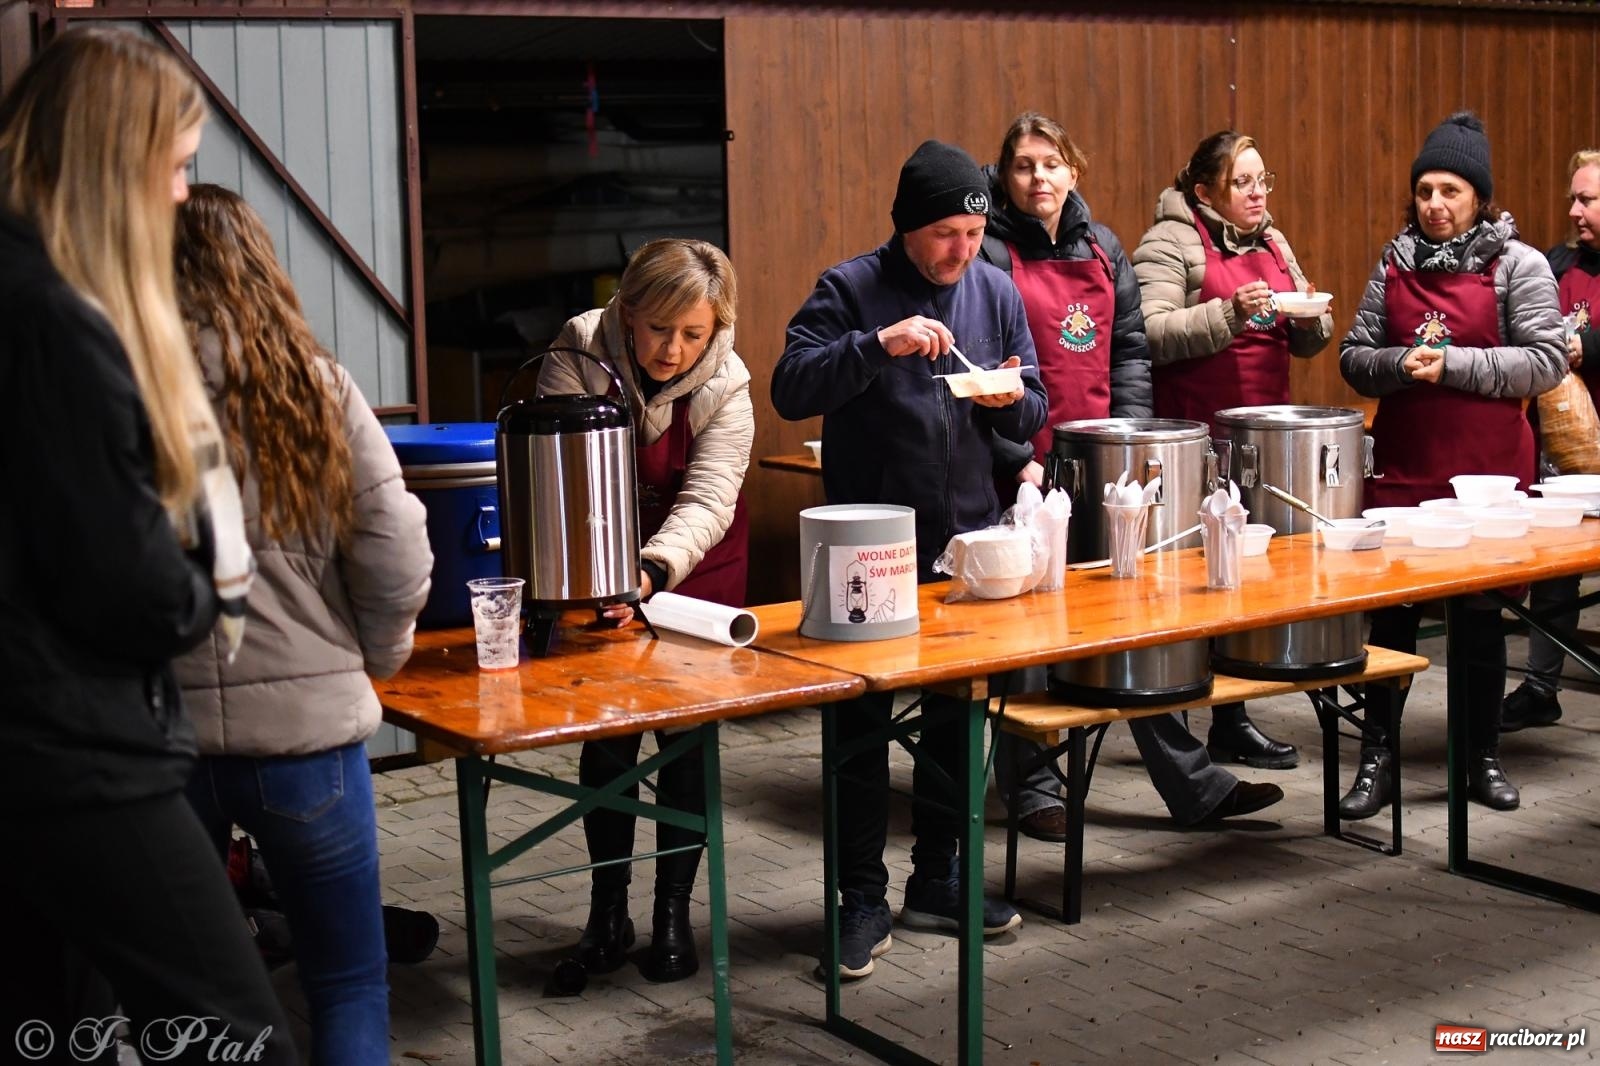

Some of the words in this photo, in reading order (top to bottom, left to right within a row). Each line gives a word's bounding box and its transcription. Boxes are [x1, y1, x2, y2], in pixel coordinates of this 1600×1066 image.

[1067, 303, 1089, 313] OSP
[1424, 310, 1447, 321] OSP
[1058, 337, 1097, 353] OWSISZCZE
[857, 549, 897, 562] WOLNE
[869, 566, 888, 578] ŚW
[890, 562, 916, 577] MARC
